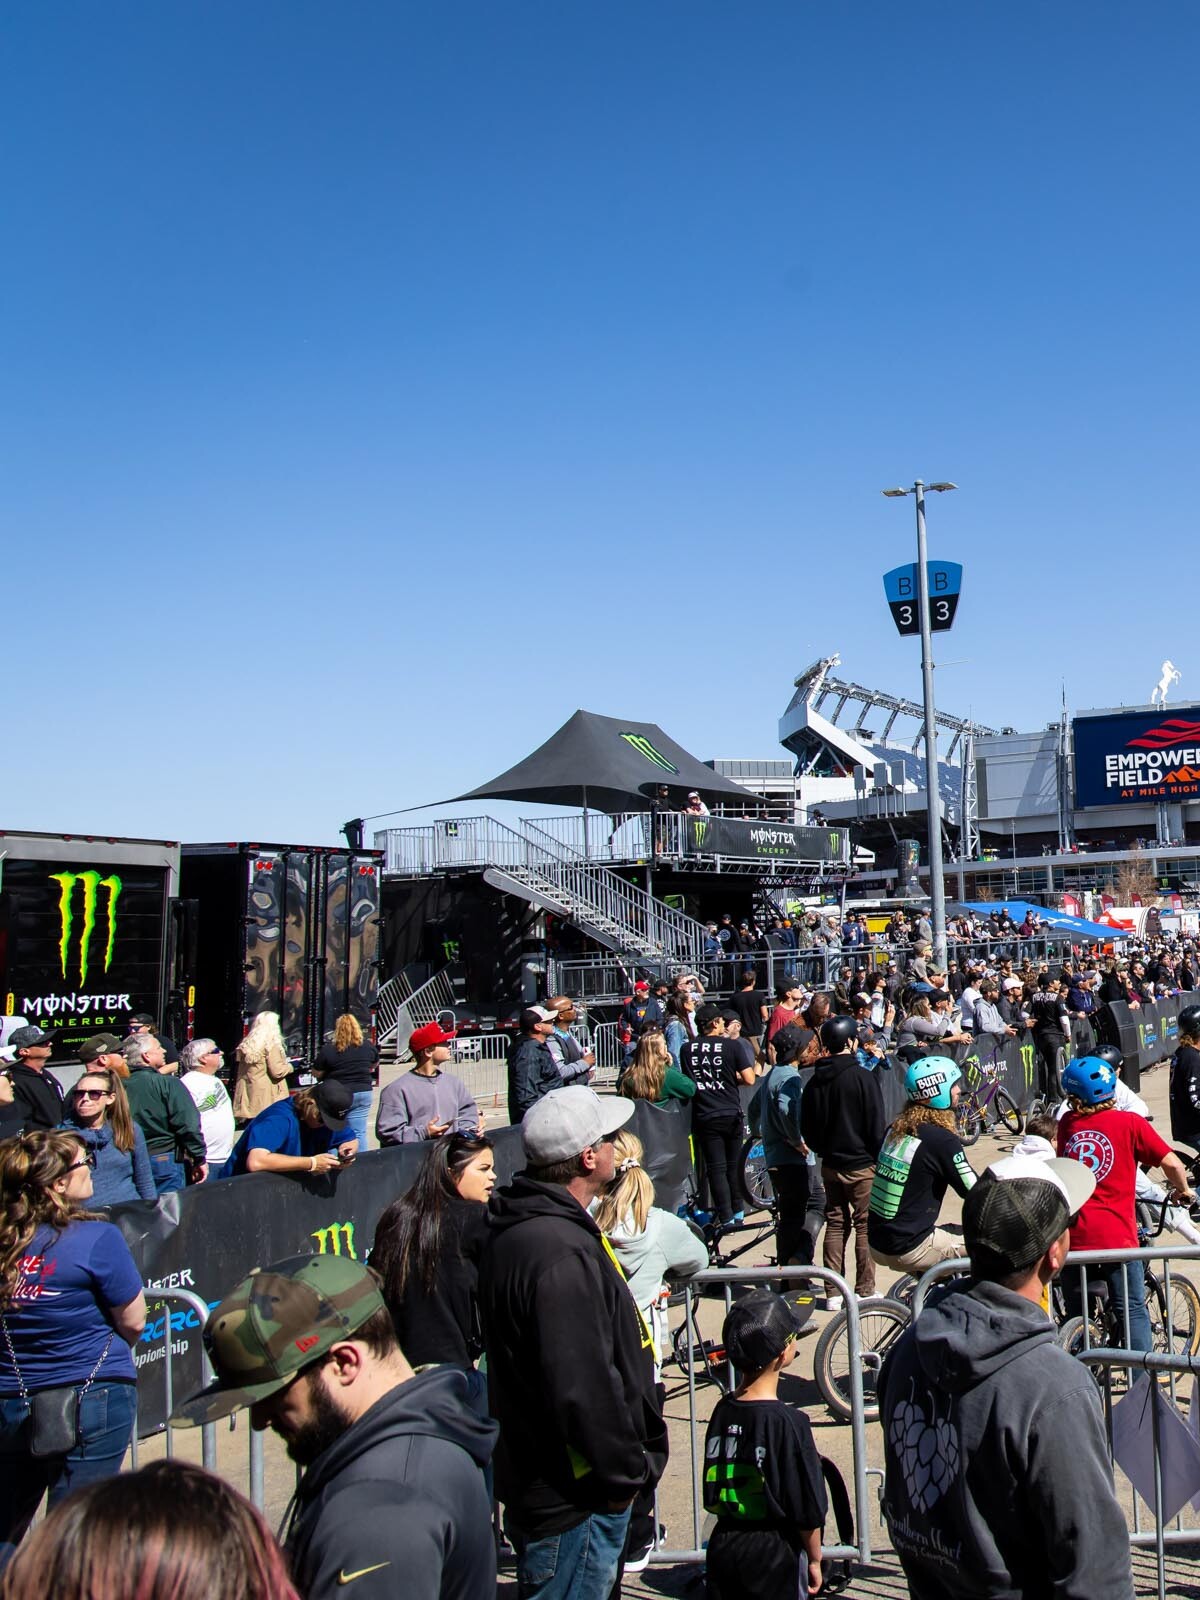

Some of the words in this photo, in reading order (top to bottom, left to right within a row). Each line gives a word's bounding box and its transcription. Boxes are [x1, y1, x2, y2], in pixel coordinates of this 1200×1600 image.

[898, 577, 912, 595] B
[935, 572, 948, 591] B
[899, 605, 912, 625] 3
[936, 601, 949, 621] 3
[1106, 769, 1163, 788] FIELD
[1121, 789, 1135, 798] AT
[1139, 787, 1166, 797] MILE
[1170, 785, 1199, 794] HIGH
[750, 827, 797, 846] MONSTER
[757, 846, 790, 854] ENERGY
[22, 992, 133, 1017] MONSTER
[40, 1016, 117, 1028] ENERGY
[696, 1080, 726, 1091] BMX
[1073, 1141, 1100, 1171] B
